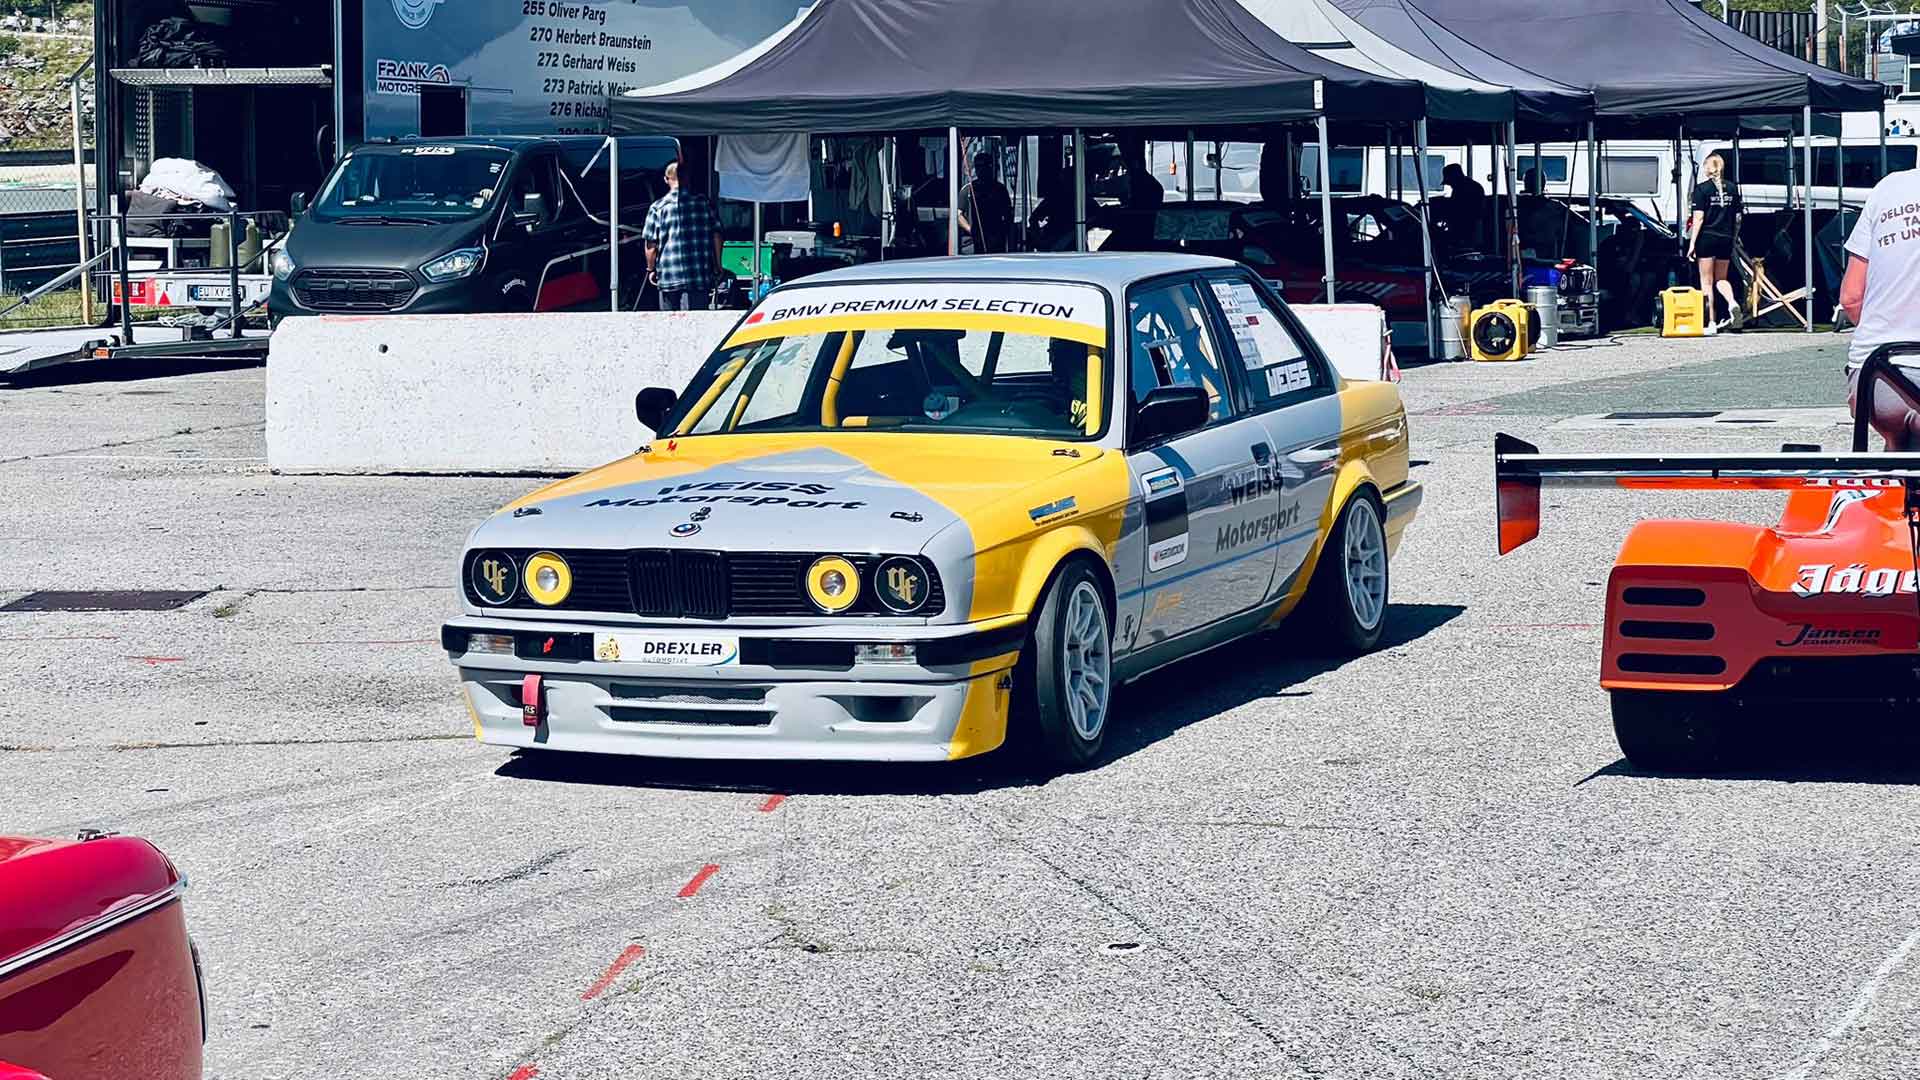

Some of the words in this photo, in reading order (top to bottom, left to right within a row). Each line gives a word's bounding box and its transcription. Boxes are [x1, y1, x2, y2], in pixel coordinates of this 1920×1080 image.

[523, 1, 545, 15] 255
[549, 3, 580, 19] Oliver
[582, 6, 606, 25] Parg
[530, 27, 552, 42] 270
[556, 29, 596, 45] Herbert
[599, 32, 651, 50] Braunstein
[378, 62, 429, 78] FRANK
[537, 53, 559, 67] 272
[562, 54, 604, 70] Gerhard
[607, 57, 636, 73] Weiss
[543, 78, 565, 93] 273
[568, 80, 604, 96] Patrick
[550, 102, 571, 116] 276
[1878, 233, 1897, 247] YET
[771, 303, 827, 321] BMW
[830, 298, 937, 314] PREMIUM
[943, 298, 1075, 319] SELECTION
[657, 481, 835, 495] WEISS
[1230, 468, 1284, 506] WEISS
[584, 494, 868, 509] Motorsport
[1216, 501, 1301, 553] Motorsport
[1776, 623, 1882, 647] Jansen
[643, 641, 723, 655] DREXLER
